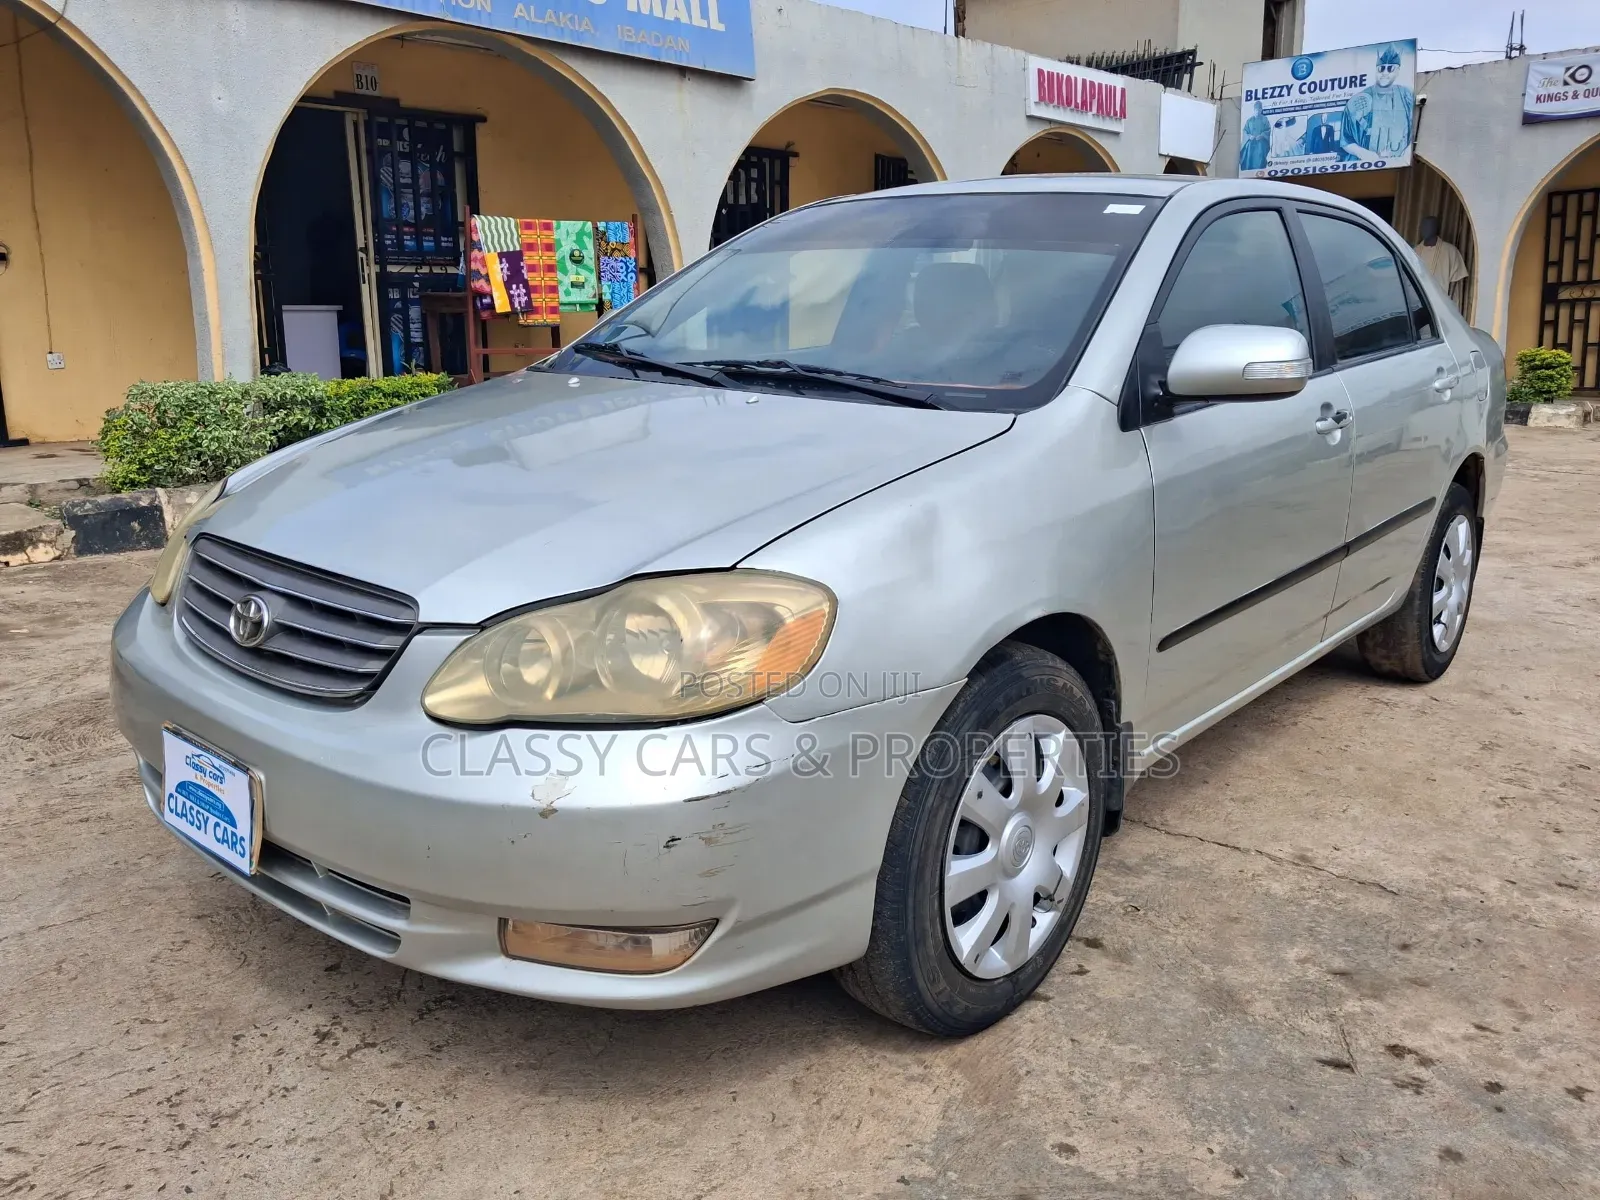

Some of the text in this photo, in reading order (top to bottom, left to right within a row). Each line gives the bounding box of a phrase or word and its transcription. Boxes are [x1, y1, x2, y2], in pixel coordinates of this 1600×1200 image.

[617, 24, 690, 53] IBADAN
[355, 73, 378, 92] B10
[1037, 67, 1127, 120] BUKOLAPAULA
[1245, 74, 1367, 102] BLEZZY COUTURE
[1535, 87, 1600, 104] KINGS & QU
[1267, 160, 1387, 178] 09051691400
[185, 754, 209, 778] Classy
[208, 770, 225, 785] cars
[167, 792, 246, 859] CLASSY CARS
